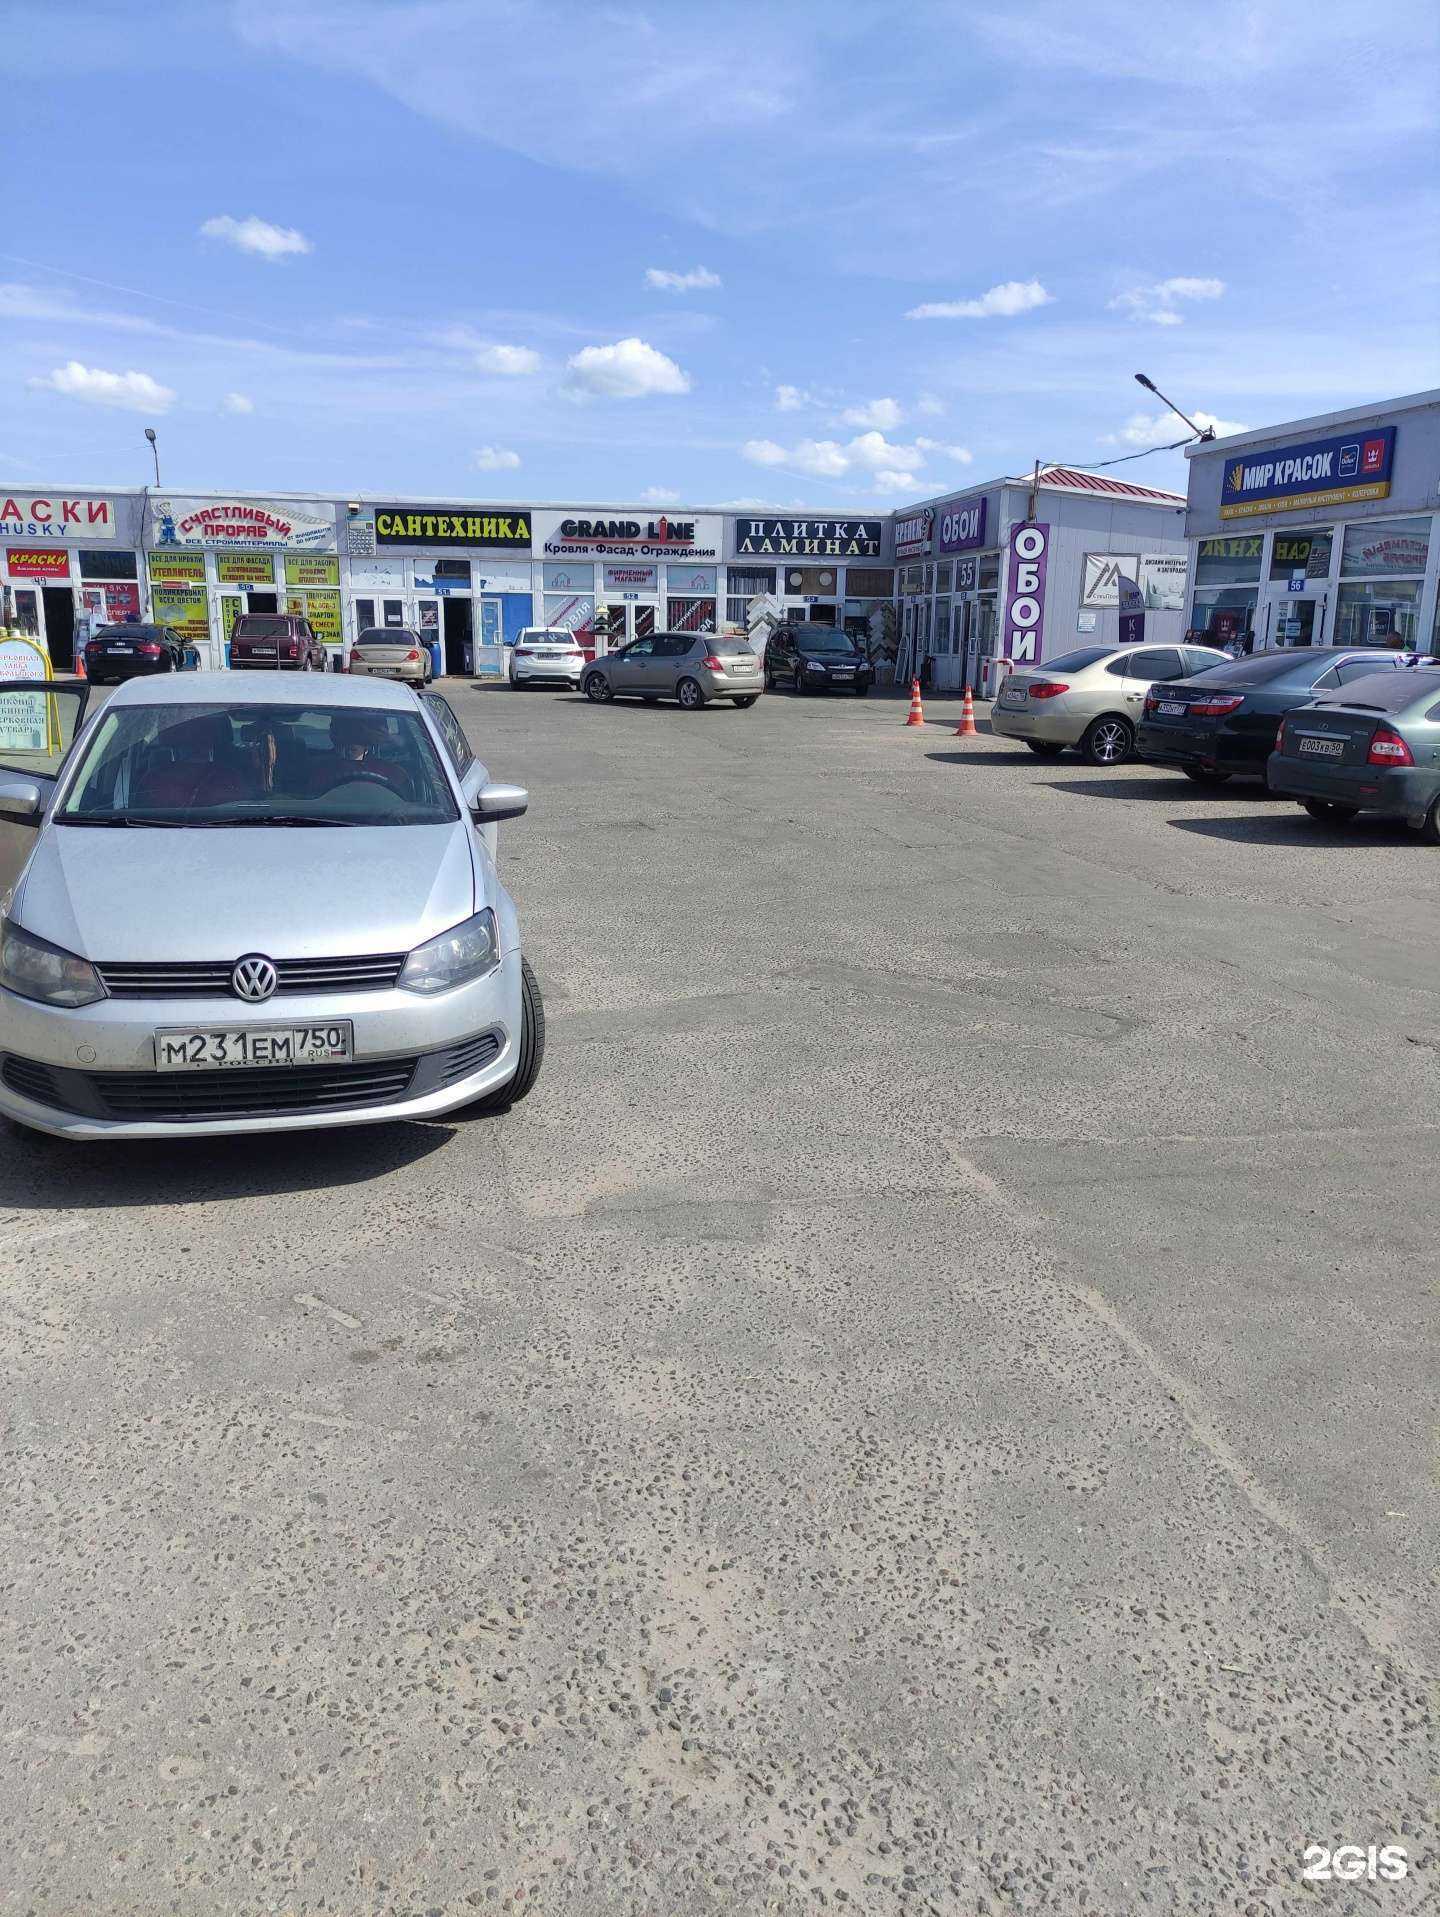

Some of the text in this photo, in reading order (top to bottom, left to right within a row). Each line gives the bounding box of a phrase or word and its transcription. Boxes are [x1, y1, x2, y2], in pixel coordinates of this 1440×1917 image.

[1243, 452, 1334, 490] МИР КРАСОК
[0, 499, 108, 523] АСКИ
[180, 506, 292, 536] СЧАСТЛИВЫЙ
[377, 515, 531, 539] САНТЕХНИКА
[560, 515, 695, 543] GRAND LINE
[942, 508, 979, 544] ОБОИ
[0, 523, 67, 536] HUSKY
[204, 525, 268, 538] ПРОРАБ
[749, 521, 868, 539] ПЛИТКА
[205, 539, 288, 547] СТРОЙМАТЕРИАЛЫ
[544, 542, 716, 557] Кровля Фасад Ограждения
[739, 538, 878, 555] ЛАМИНАТ
[9, 553, 67, 566] КРАСКИ
[152, 568, 205, 578] УТЕПЛИТЕЛЬ
[607, 569, 653, 577] ФИРМЕННЫЙ
[614, 576, 647, 584] МАГАЗИН
[960, 562, 973, 586] 55
[1011, 527, 1045, 661] ОБОИ
[1290, 582, 1301, 591] 56
[307, 1049, 331, 1057] RUS
